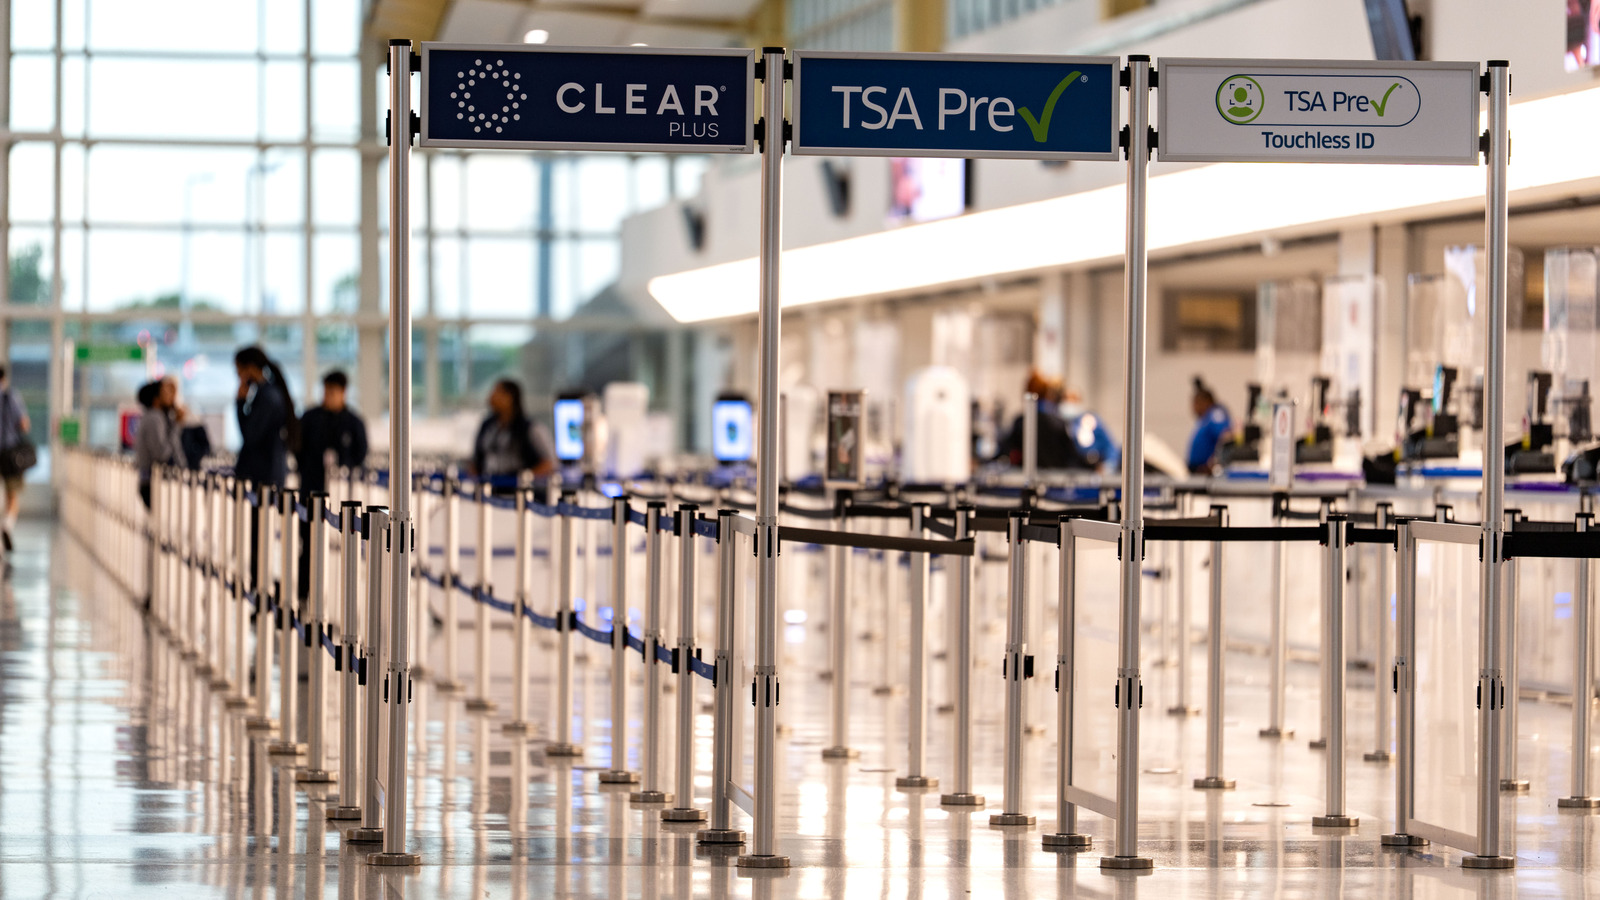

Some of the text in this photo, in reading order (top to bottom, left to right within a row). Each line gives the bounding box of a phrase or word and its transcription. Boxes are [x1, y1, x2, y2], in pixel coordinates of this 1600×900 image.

[831, 85, 1015, 132] TSA Pre
[1284, 90, 1369, 112] TSA Pre
[669, 122, 720, 138] PLUS
[1261, 130, 1375, 149] Touchless ID
